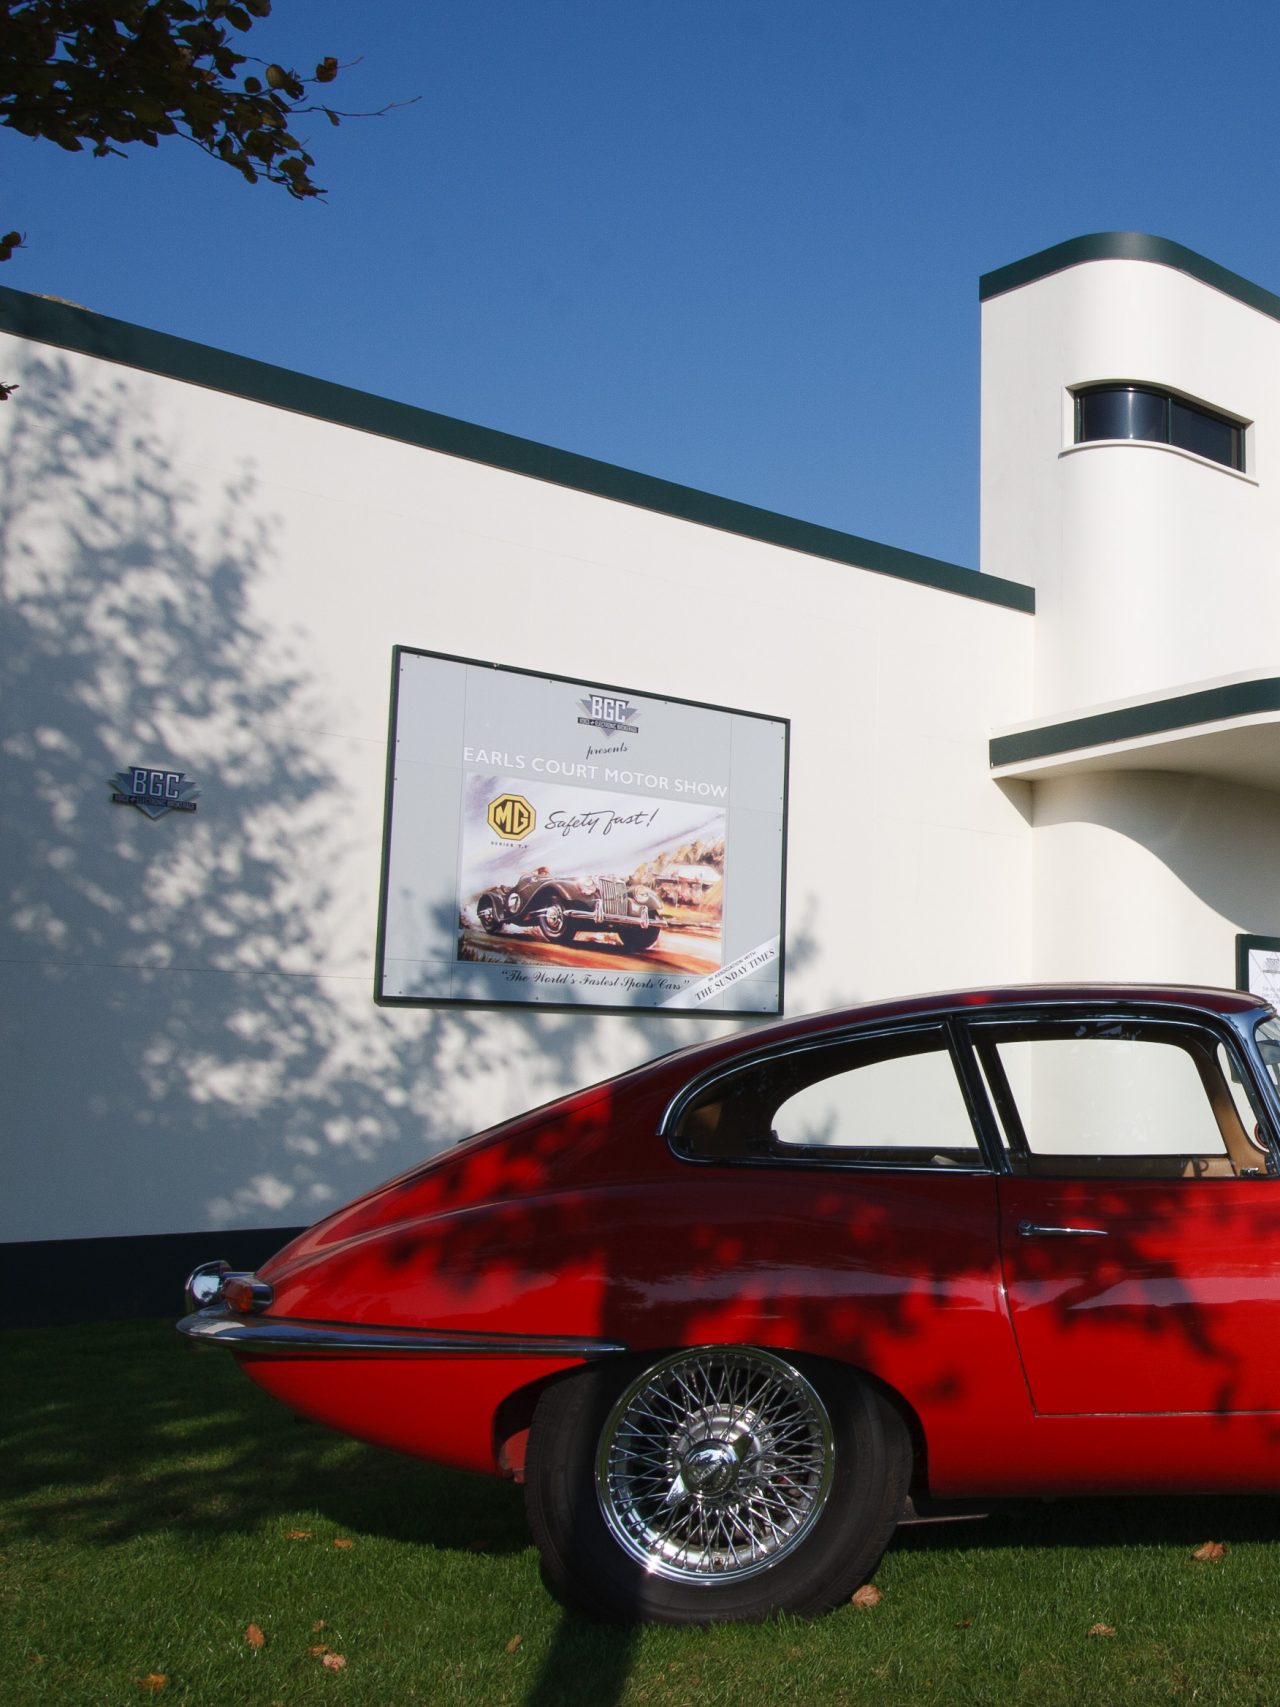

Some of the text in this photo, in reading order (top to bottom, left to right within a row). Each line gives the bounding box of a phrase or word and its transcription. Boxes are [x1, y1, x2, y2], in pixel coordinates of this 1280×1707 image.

[592, 696, 626, 722] BGC
[586, 742, 628, 760] presents
[133, 769, 180, 798] BGC
[463, 747, 728, 798] EARLS COURT MOTOR SHOW
[495, 801, 529, 834] MG
[545, 809, 602, 836] Safety
[511, 896, 519, 909] 7
[579, 974, 618, 987] Fastest
[620, 976, 654, 991] Sports
[695, 948, 775, 1001] THE SUNDAY TIMES
